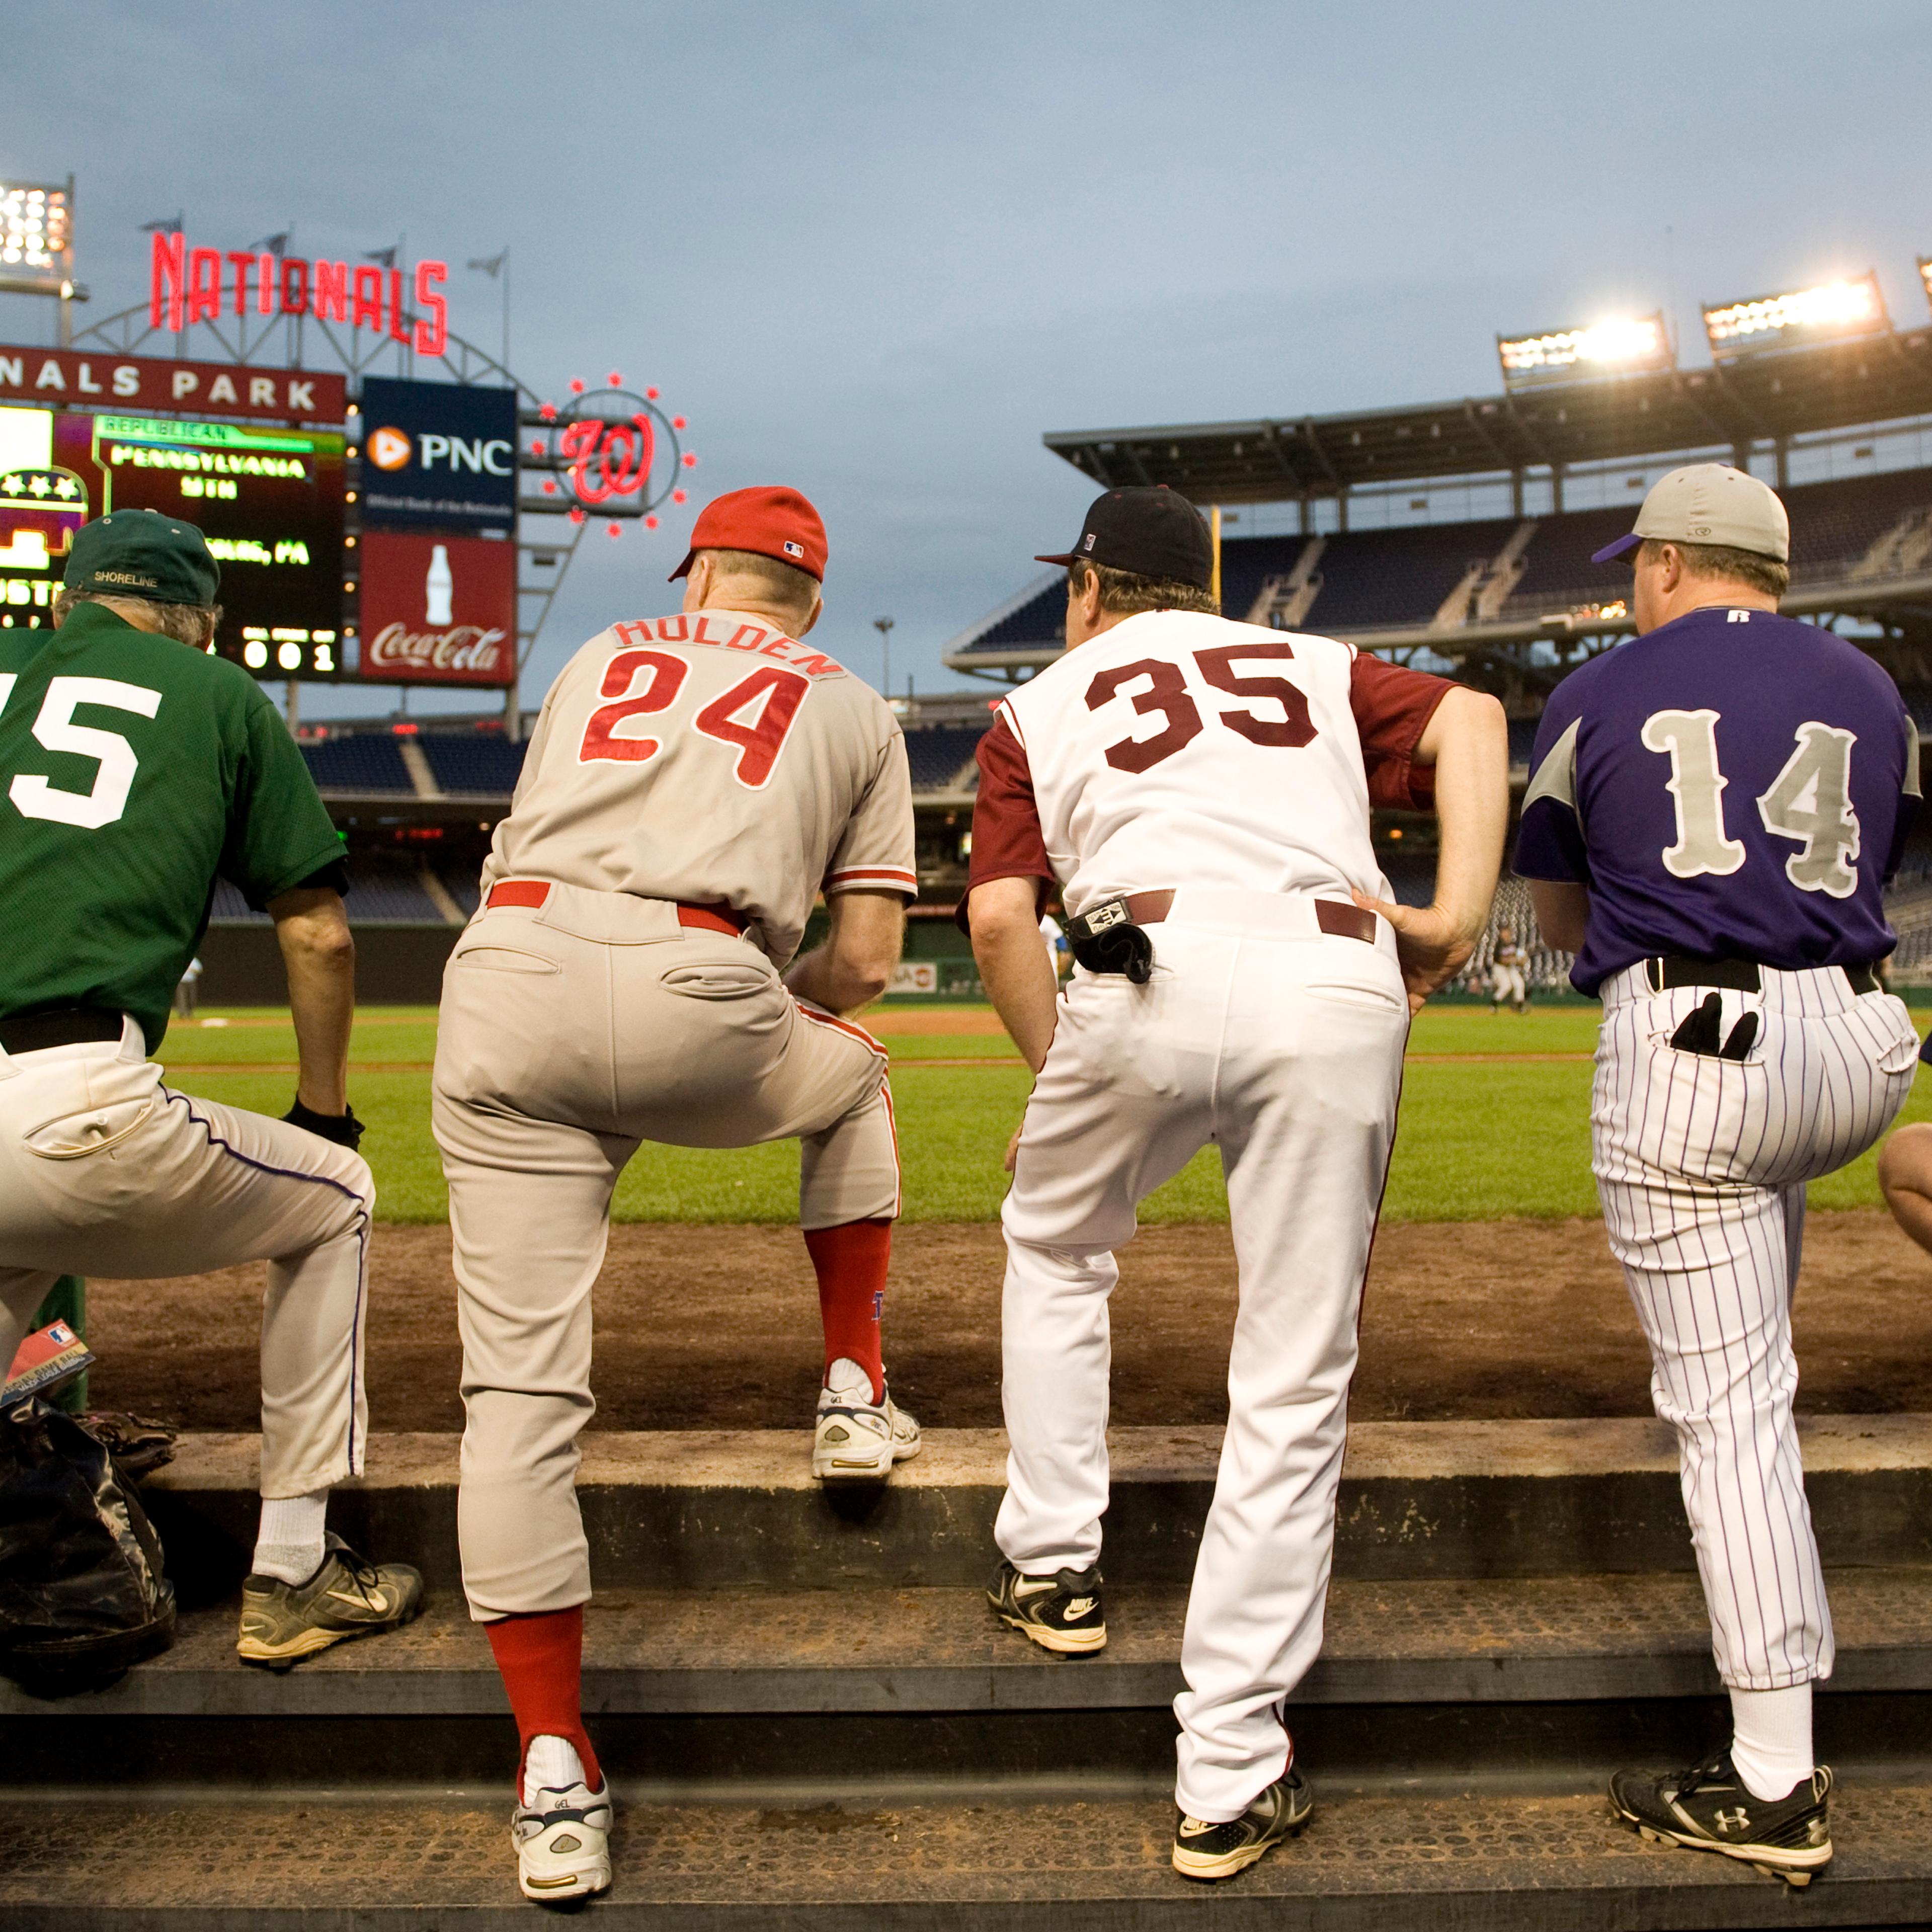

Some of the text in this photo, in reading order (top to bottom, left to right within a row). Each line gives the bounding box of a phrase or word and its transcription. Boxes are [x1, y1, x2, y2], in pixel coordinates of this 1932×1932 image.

[151, 231, 448, 356] NATIONALS
[172, 370, 315, 411] PARK
[111, 444, 306, 479] PENNSYLVANIA
[417, 434, 513, 476] PNC
[94, 571, 158, 588] SHORELINE
[314, 644, 335, 672] 1
[370, 622, 506, 671] Coca-Cola
[614, 614, 844, 677] HOLDEN
[577, 649, 813, 791] 24
[1084, 642, 1319, 774] 35
[1641, 708, 1861, 899] 14
[1070, 1597, 1093, 1611] NIKE
[554, 1799, 571, 1809] GEL
